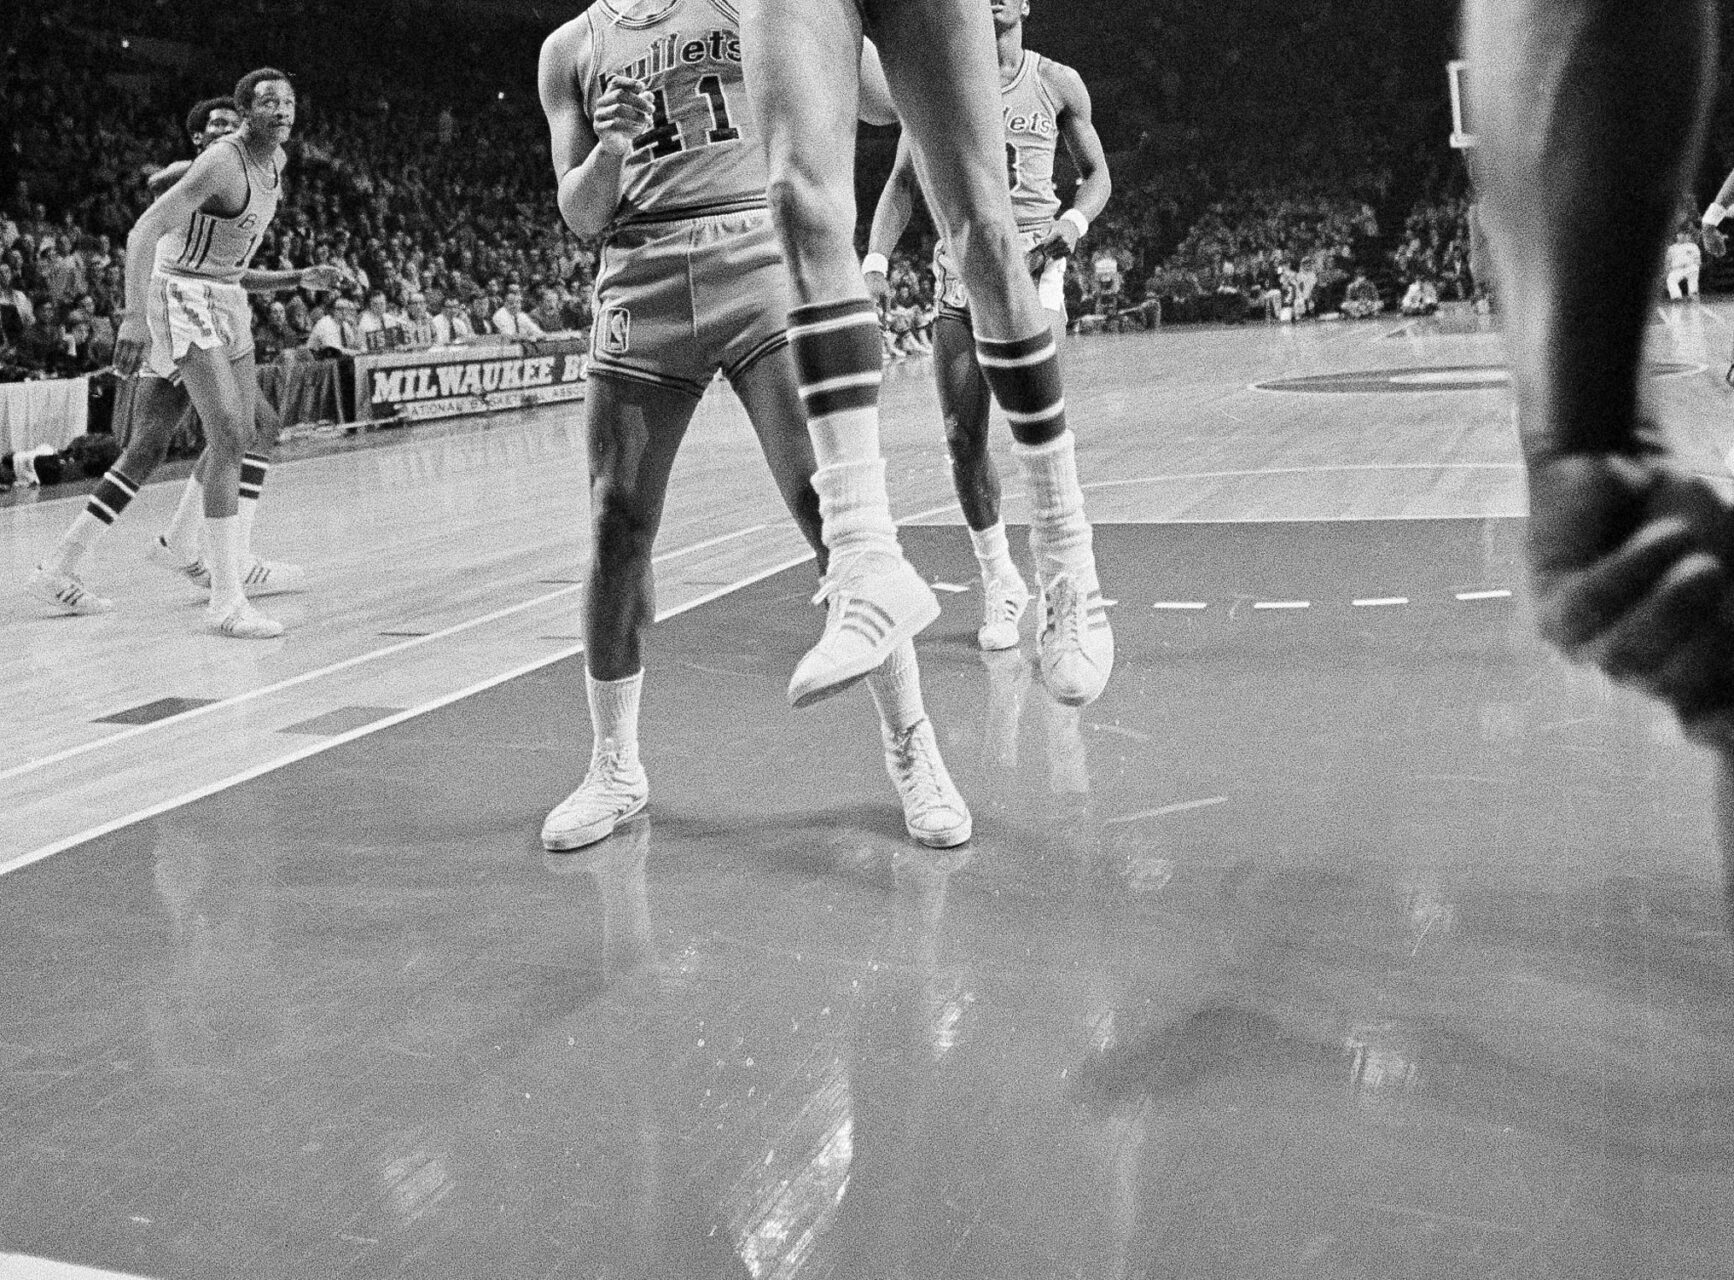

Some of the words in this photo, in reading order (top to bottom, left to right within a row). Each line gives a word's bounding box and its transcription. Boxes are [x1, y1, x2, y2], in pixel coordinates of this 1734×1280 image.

[631, 73, 742, 161] 41
[371, 355, 556, 404] MILWAUKEE
[402, 399, 464, 418] ATIONAL
